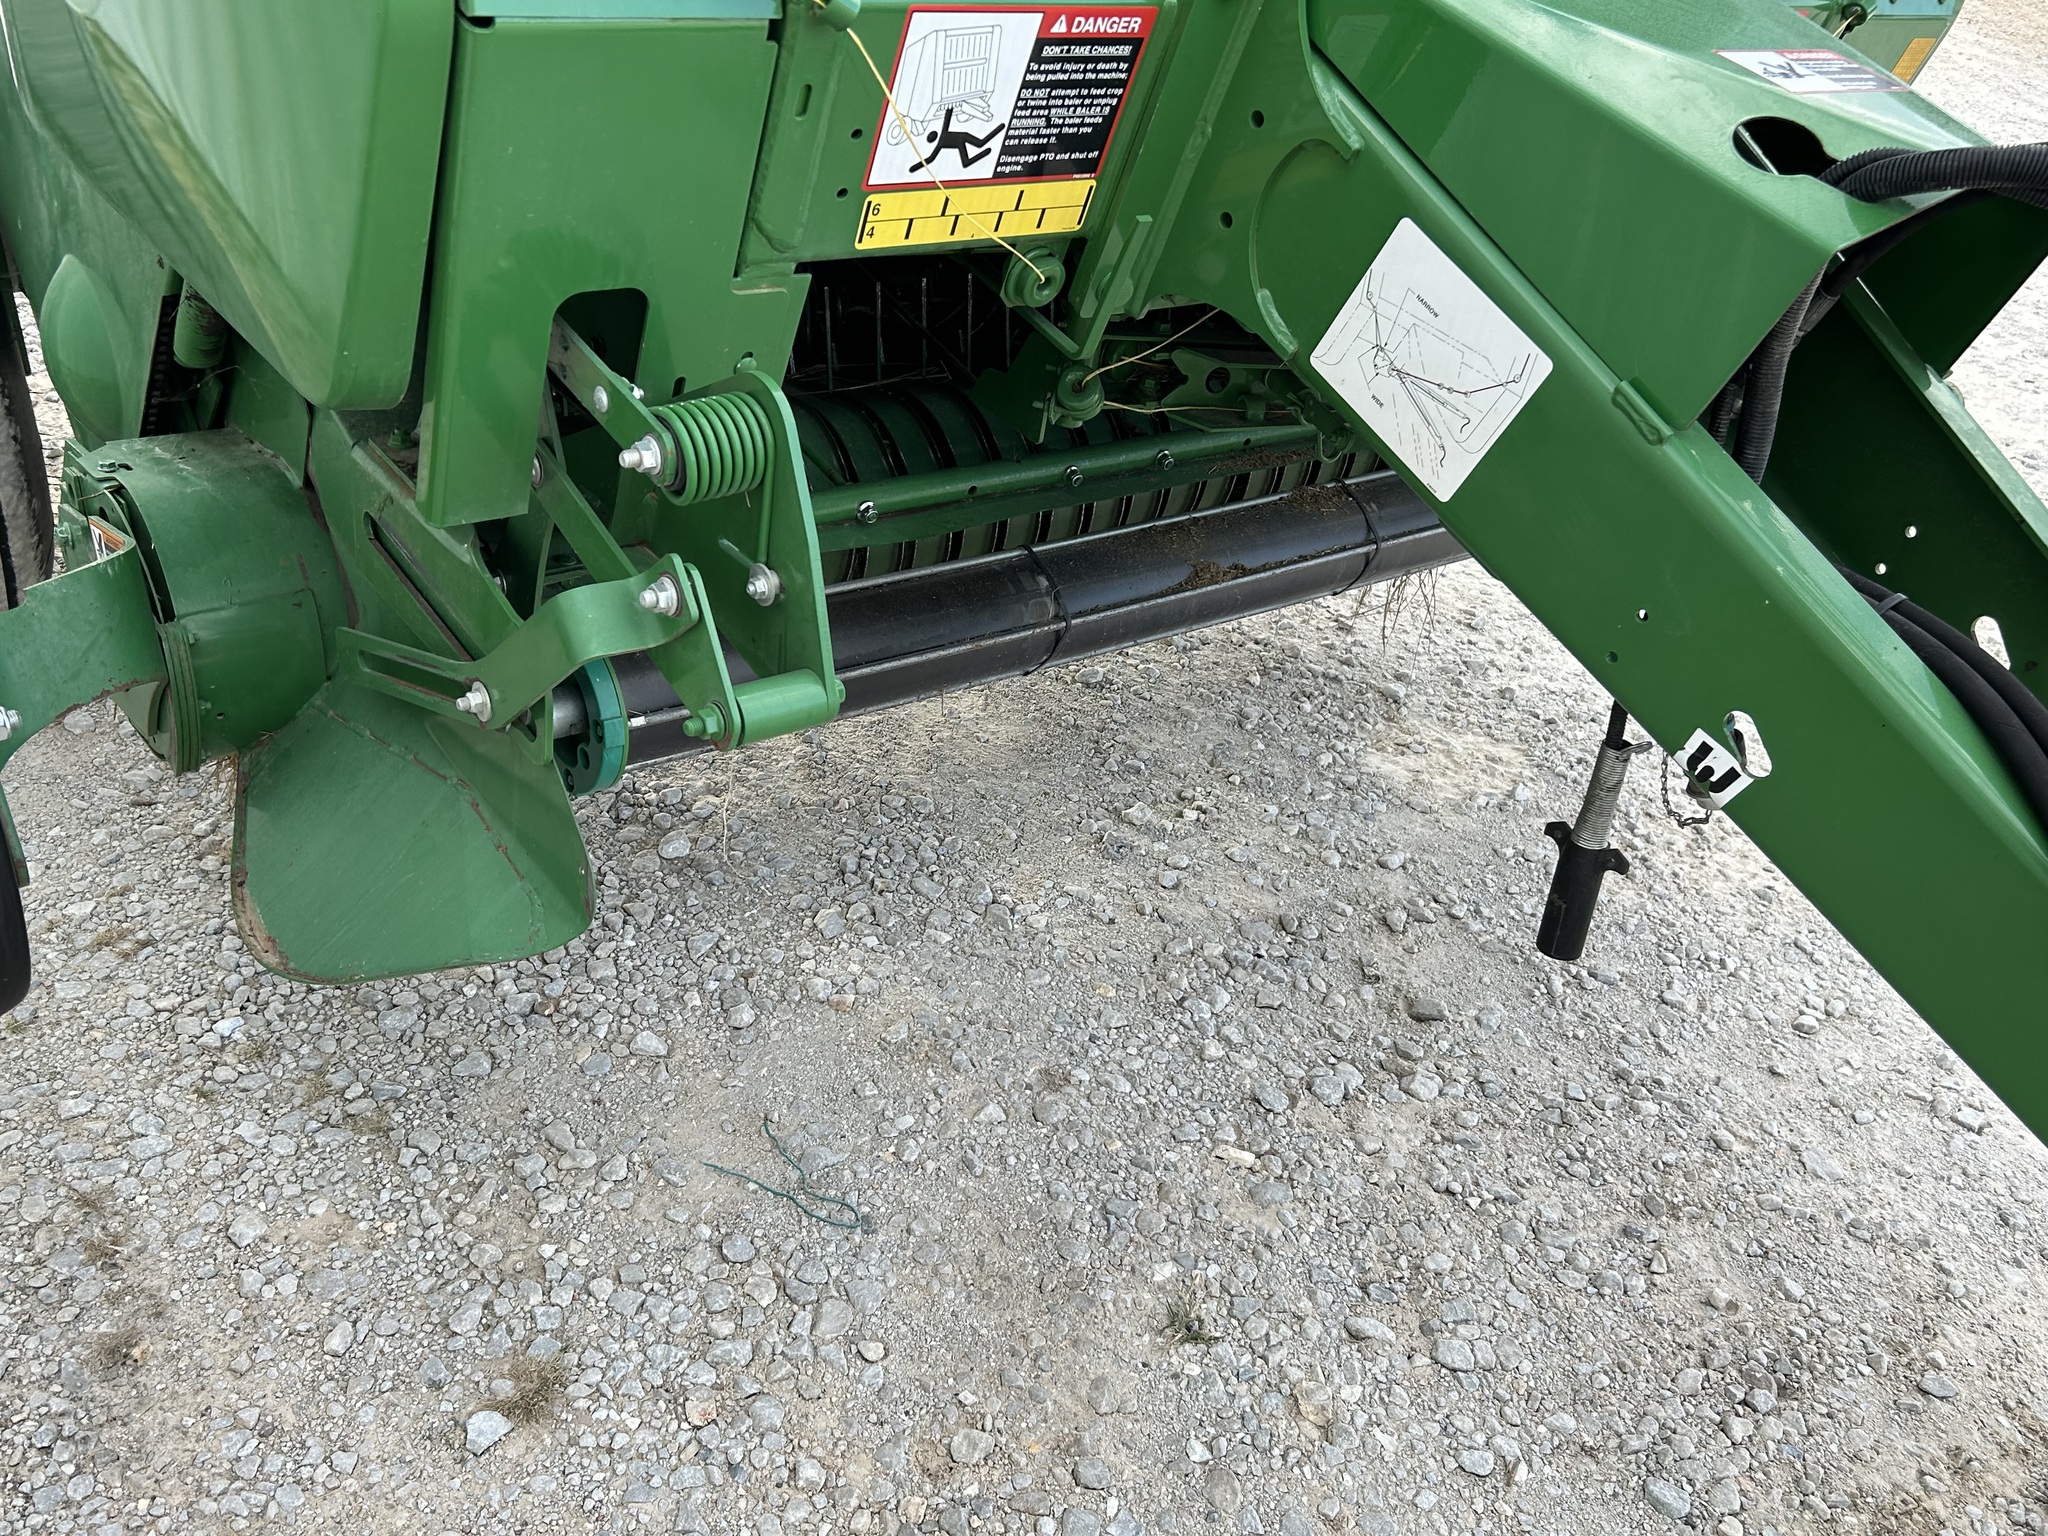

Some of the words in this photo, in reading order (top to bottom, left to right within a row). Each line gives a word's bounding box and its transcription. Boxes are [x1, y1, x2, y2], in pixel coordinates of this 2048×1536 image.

[1071, 17, 1142, 34] DANGER
[1042, 46, 1068, 55] DON'T
[1070, 46, 1091, 55] TAKE
[1092, 45, 1132, 55] CHANCES!
[1063, 63, 1084, 71] injury
[1119, 62, 1128, 71] by
[1026, 73, 1045, 82] being
[1047, 73, 1068, 81] pulled
[1021, 89, 1031, 98] DO
[1033, 89, 1049, 97] NOT
[1051, 88, 1079, 97] attempt
[1094, 97, 1117, 105] unplug
[1050, 107, 1074, 116] WHILE
[1076, 107, 1101, 115] BALER
[1102, 106, 1110, 115] IS
[1000, 155, 1038, 163] Disengage
[997, 164, 1024, 173] engine.
[872, 203, 881, 216] 6
[866, 226, 875, 238] 4
[1416, 294, 1440, 318] NARROW
[1370, 394, 1384, 409] WIDE
